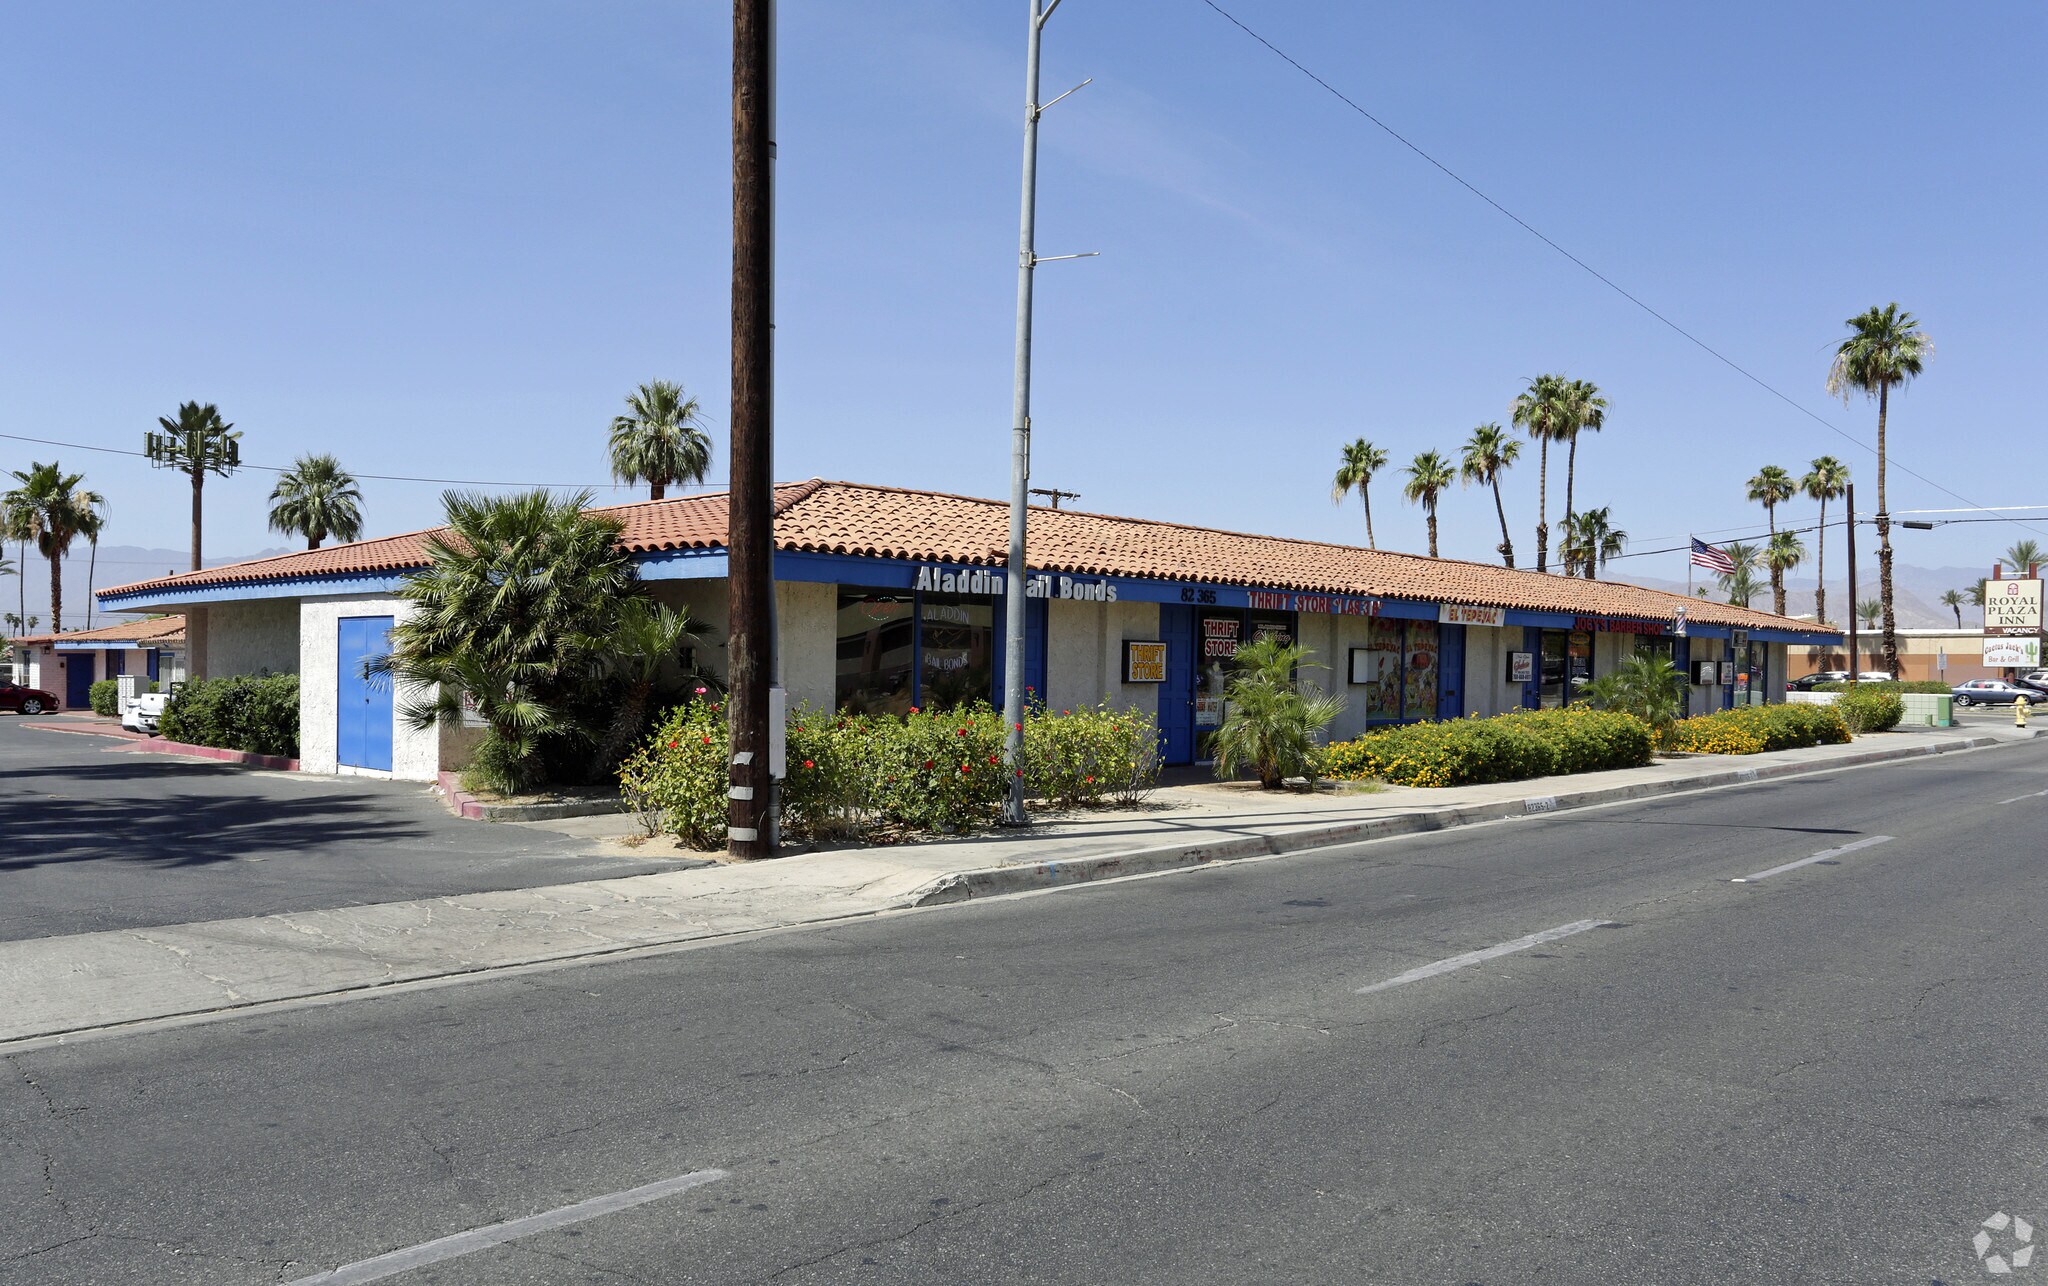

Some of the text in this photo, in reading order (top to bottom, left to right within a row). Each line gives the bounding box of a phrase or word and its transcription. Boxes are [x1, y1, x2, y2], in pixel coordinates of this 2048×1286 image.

[915, 565, 1117, 602] Aladdin ail Bonds
[1181, 587, 1217, 604] 82 365
[1248, 591, 1291, 610] THRIFT
[1295, 595, 1332, 613] STORE
[1989, 597, 2038, 606] ROYAL
[925, 606, 969, 623] ALADDIN
[1449, 607, 1459, 621] EL
[1988, 606, 2038, 615] PLAZA
[1204, 618, 1239, 638] THRIFT
[1609, 619, 1642, 634] BARBER
[1643, 623, 1664, 635] SHOP
[1999, 616, 2026, 625] INN
[1131, 644, 1164, 662] THRIFT
[1205, 639, 1237, 657] STORE
[1985, 642, 2024, 655] Cactus Jack's
[1132, 662, 1163, 679] STORE
